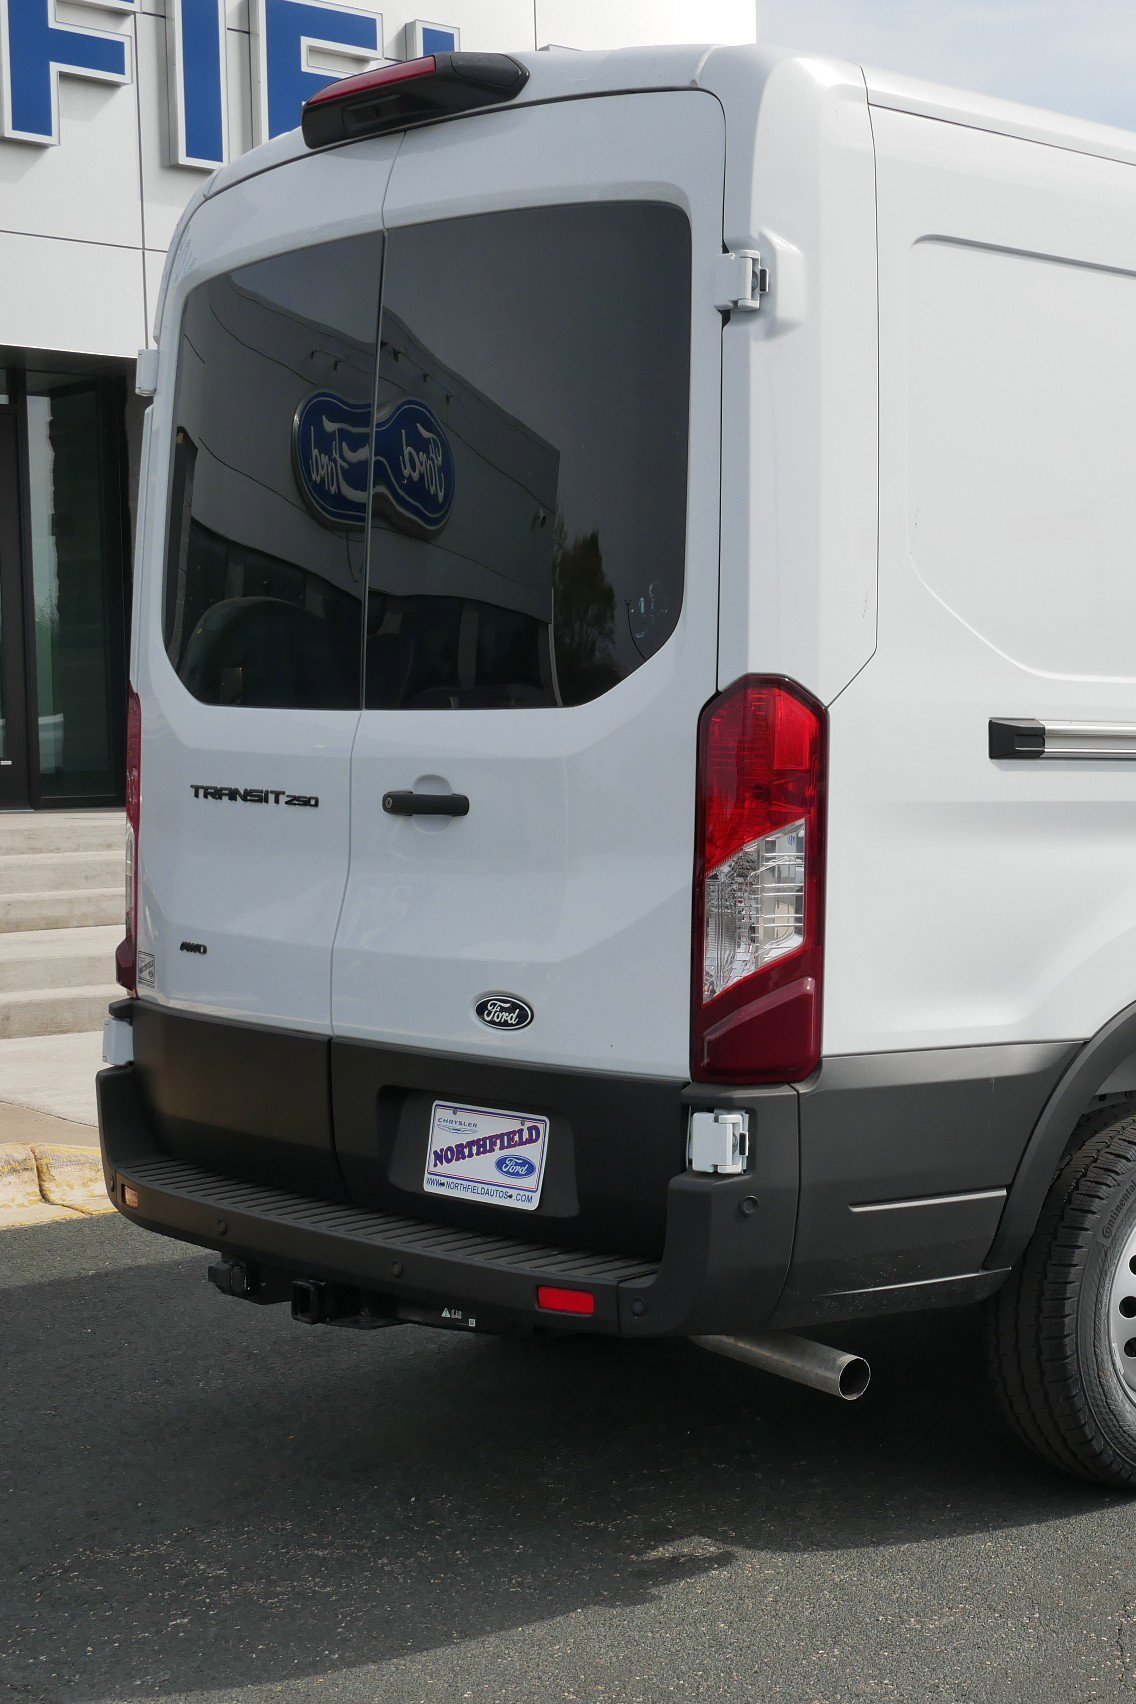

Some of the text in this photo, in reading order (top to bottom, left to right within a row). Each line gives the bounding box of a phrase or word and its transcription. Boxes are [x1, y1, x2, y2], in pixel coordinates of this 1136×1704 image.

[189, 784, 320, 808] TRANSIT 250
[180, 941, 208, 955] AWD
[484, 1000, 520, 1024] Ford
[437, 1117, 479, 1129] CHRYSLER
[433, 1125, 541, 1168] NORTHFIELD
[502, 1157, 528, 1175] Ford
